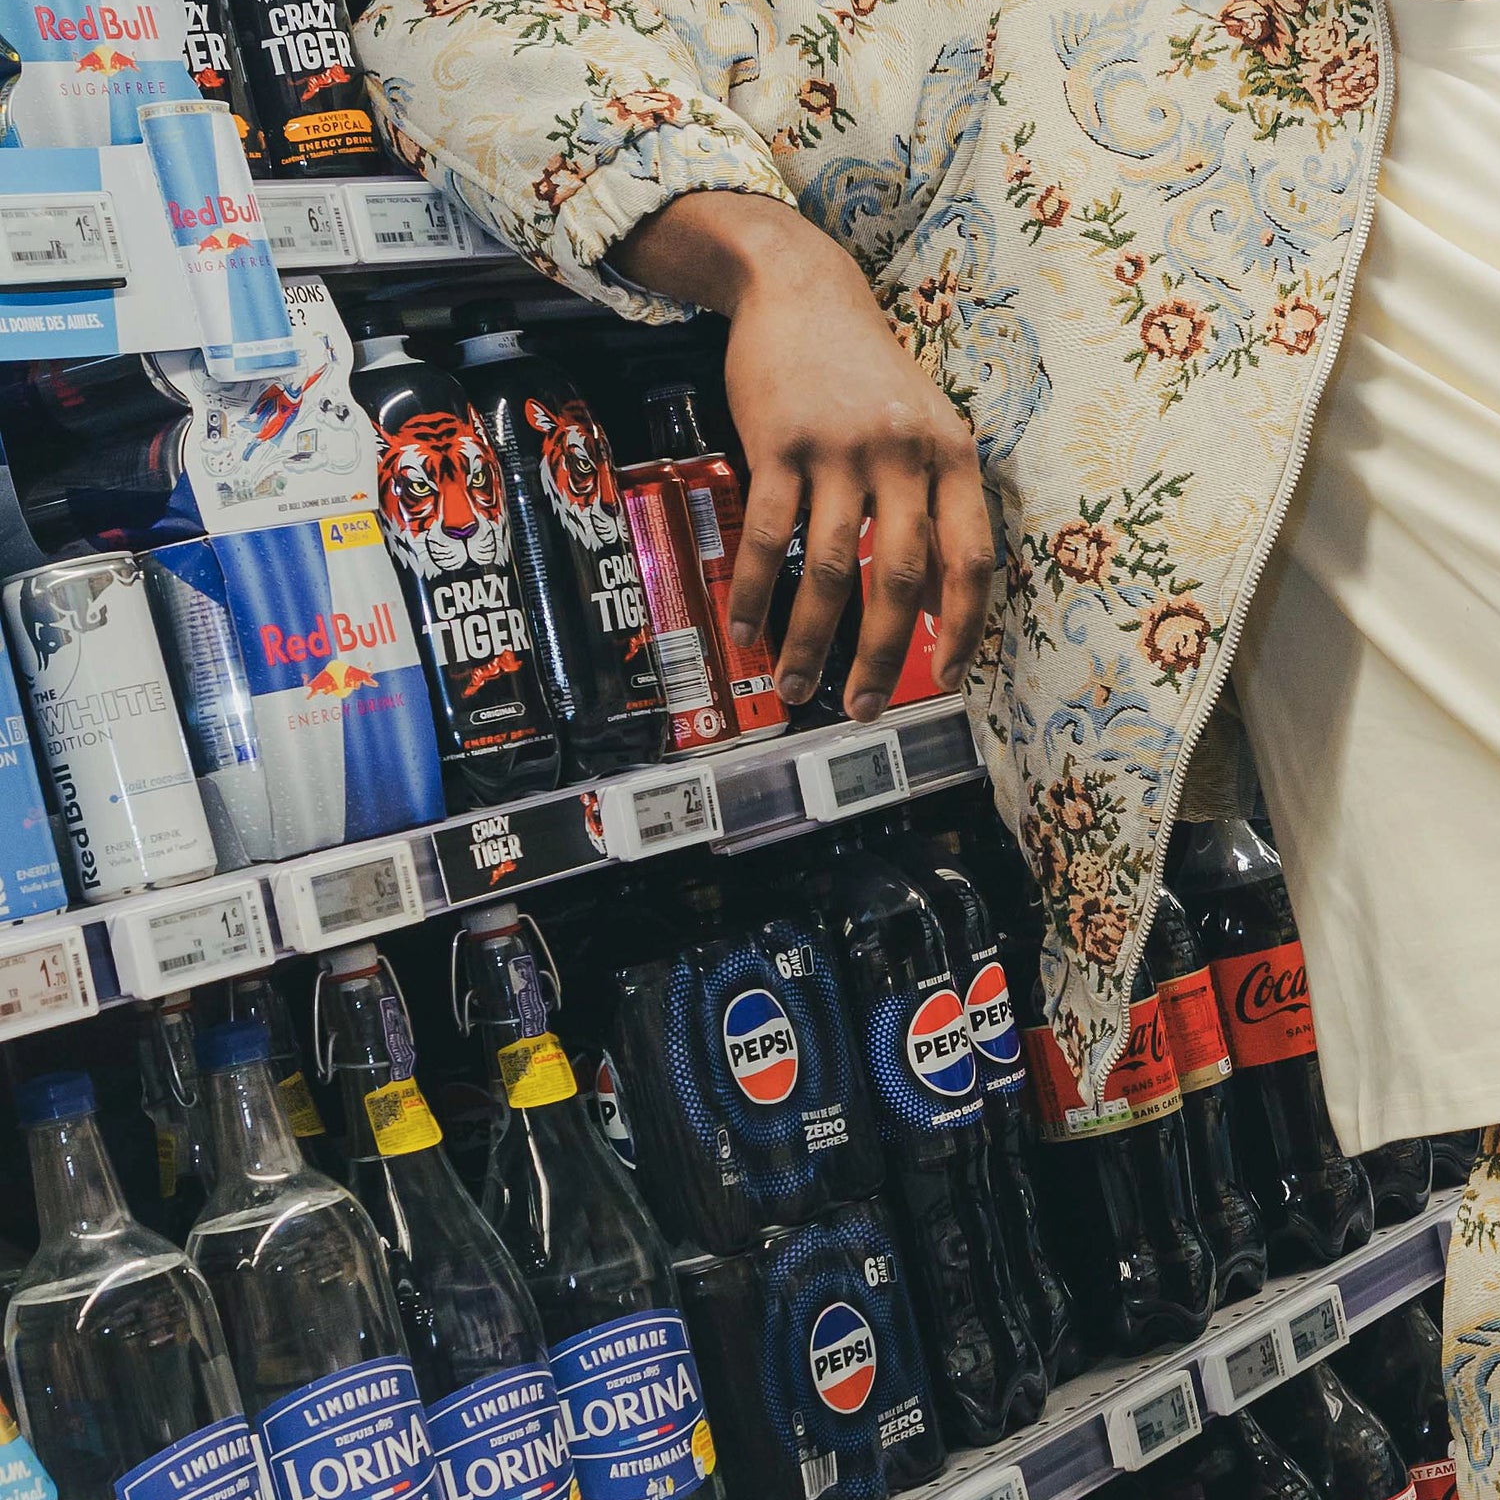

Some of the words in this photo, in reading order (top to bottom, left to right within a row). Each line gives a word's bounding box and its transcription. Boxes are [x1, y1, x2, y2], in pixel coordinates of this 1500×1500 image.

[34, 5, 99, 41] Red
[99, 5, 159, 40] Bull
[268, 0, 337, 37] CRAZY
[261, 30, 356, 76] TIGER
[61, 81, 167, 97] SUGARFREE
[299, 138, 342, 152] ENERGY
[346, 135, 374, 146] DRINK
[304, 120, 365, 136] TROPICAL
[168, 196, 217, 231] Red
[218, 193, 262, 224] Bull
[187, 255, 271, 275] SUGARFREE
[10, 316, 46, 333] DONNE
[47, 315, 65, 331] DES
[330, 524, 344, 544] 4
[343, 520, 371, 533] PACK
[433, 574, 512, 621] CRAZY
[259, 613, 331, 667] Red
[330, 602, 397, 654] Bull
[422, 609, 532, 668] TIGER
[34, 688, 57, 705] THE
[39, 680, 167, 738] WHITE
[288, 702, 351, 731] ENERGY
[357, 691, 406, 717] DRINK
[479, 705, 519, 720] ORIGINAL
[47, 730, 113, 757] EDITION
[51, 762, 84, 826] Bull
[471, 815, 511, 844] CRAZY
[68, 827, 102, 891] Red
[469, 834, 524, 871] TIGER
[775, 952, 792, 980] 6
[788, 947, 804, 978] CANS
[729, 1028, 794, 1068] PEPSI
[914, 1025, 968, 1064] PEPS
[804, 1117, 846, 1142] ZÉRO
[807, 1133, 849, 1153] SUCRES
[864, 1257, 879, 1287] 6
[876, 1254, 889, 1284] CANS
[578, 1328, 668, 1372] LIMONADE
[814, 1336, 874, 1382] PEPSI
[606, 1370, 643, 1391] DEPUIS
[303, 1376, 400, 1428] LIMONADE
[461, 1381, 545, 1430] LIMONADE
[560, 1361, 699, 1444] LORINA
[335, 1423, 375, 1448] DEPUIS
[489, 1426, 525, 1449] DEPUIS
[879, 1407, 923, 1440] ZÉRO
[881, 1422, 925, 1450] SUCRES
[168, 1434, 251, 1490] LIMONADE
[609, 1437, 691, 1480] ARTISANALE
